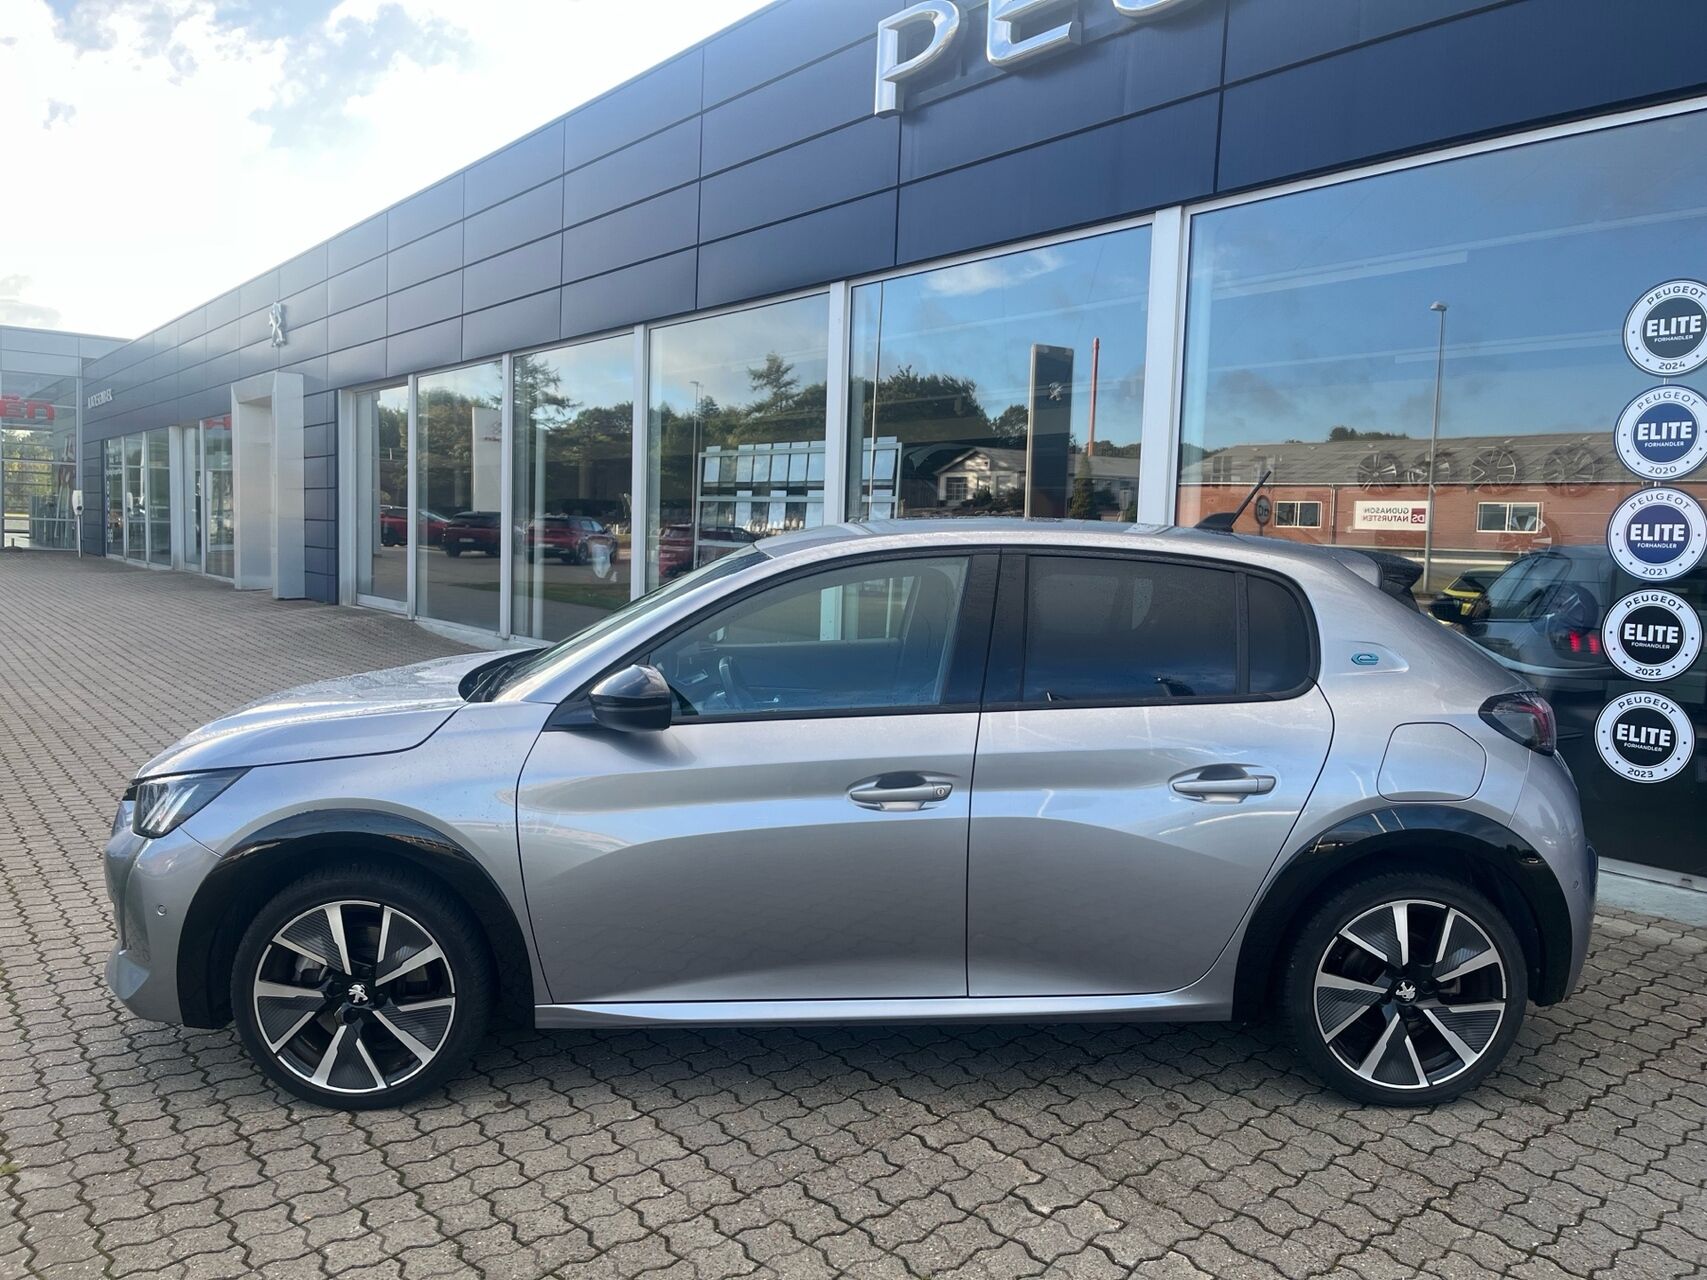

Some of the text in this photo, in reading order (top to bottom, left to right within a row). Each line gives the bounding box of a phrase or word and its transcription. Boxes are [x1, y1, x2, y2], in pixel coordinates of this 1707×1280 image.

[874, 0, 1190, 118] PE
[1647, 285, 1707, 305] PEUGEOT
[1646, 314, 1702, 337] ELITE
[1654, 335, 1694, 343] FORHANDLER
[1658, 361, 1686, 370] 2024
[1637, 391, 1699, 410] PEUGEOT
[1637, 421, 1693, 440] ELITE
[1648, 465, 1677, 475] 2020
[1629, 492, 1691, 510] PEUGEOT
[1630, 523, 1685, 541] ELITE
[1642, 567, 1668, 576] 2021
[1625, 594, 1684, 612] PEUGEOT
[1623, 623, 1679, 644] ELITE
[1631, 641, 1670, 649] FORHANDLER
[1635, 666, 1662, 676] 2022
[1618, 696, 1677, 715] PEUGEOT
[1616, 723, 1672, 747] ELITE
[1624, 742, 1663, 752] FORHANDLER
[1627, 767, 1654, 778] 2023
